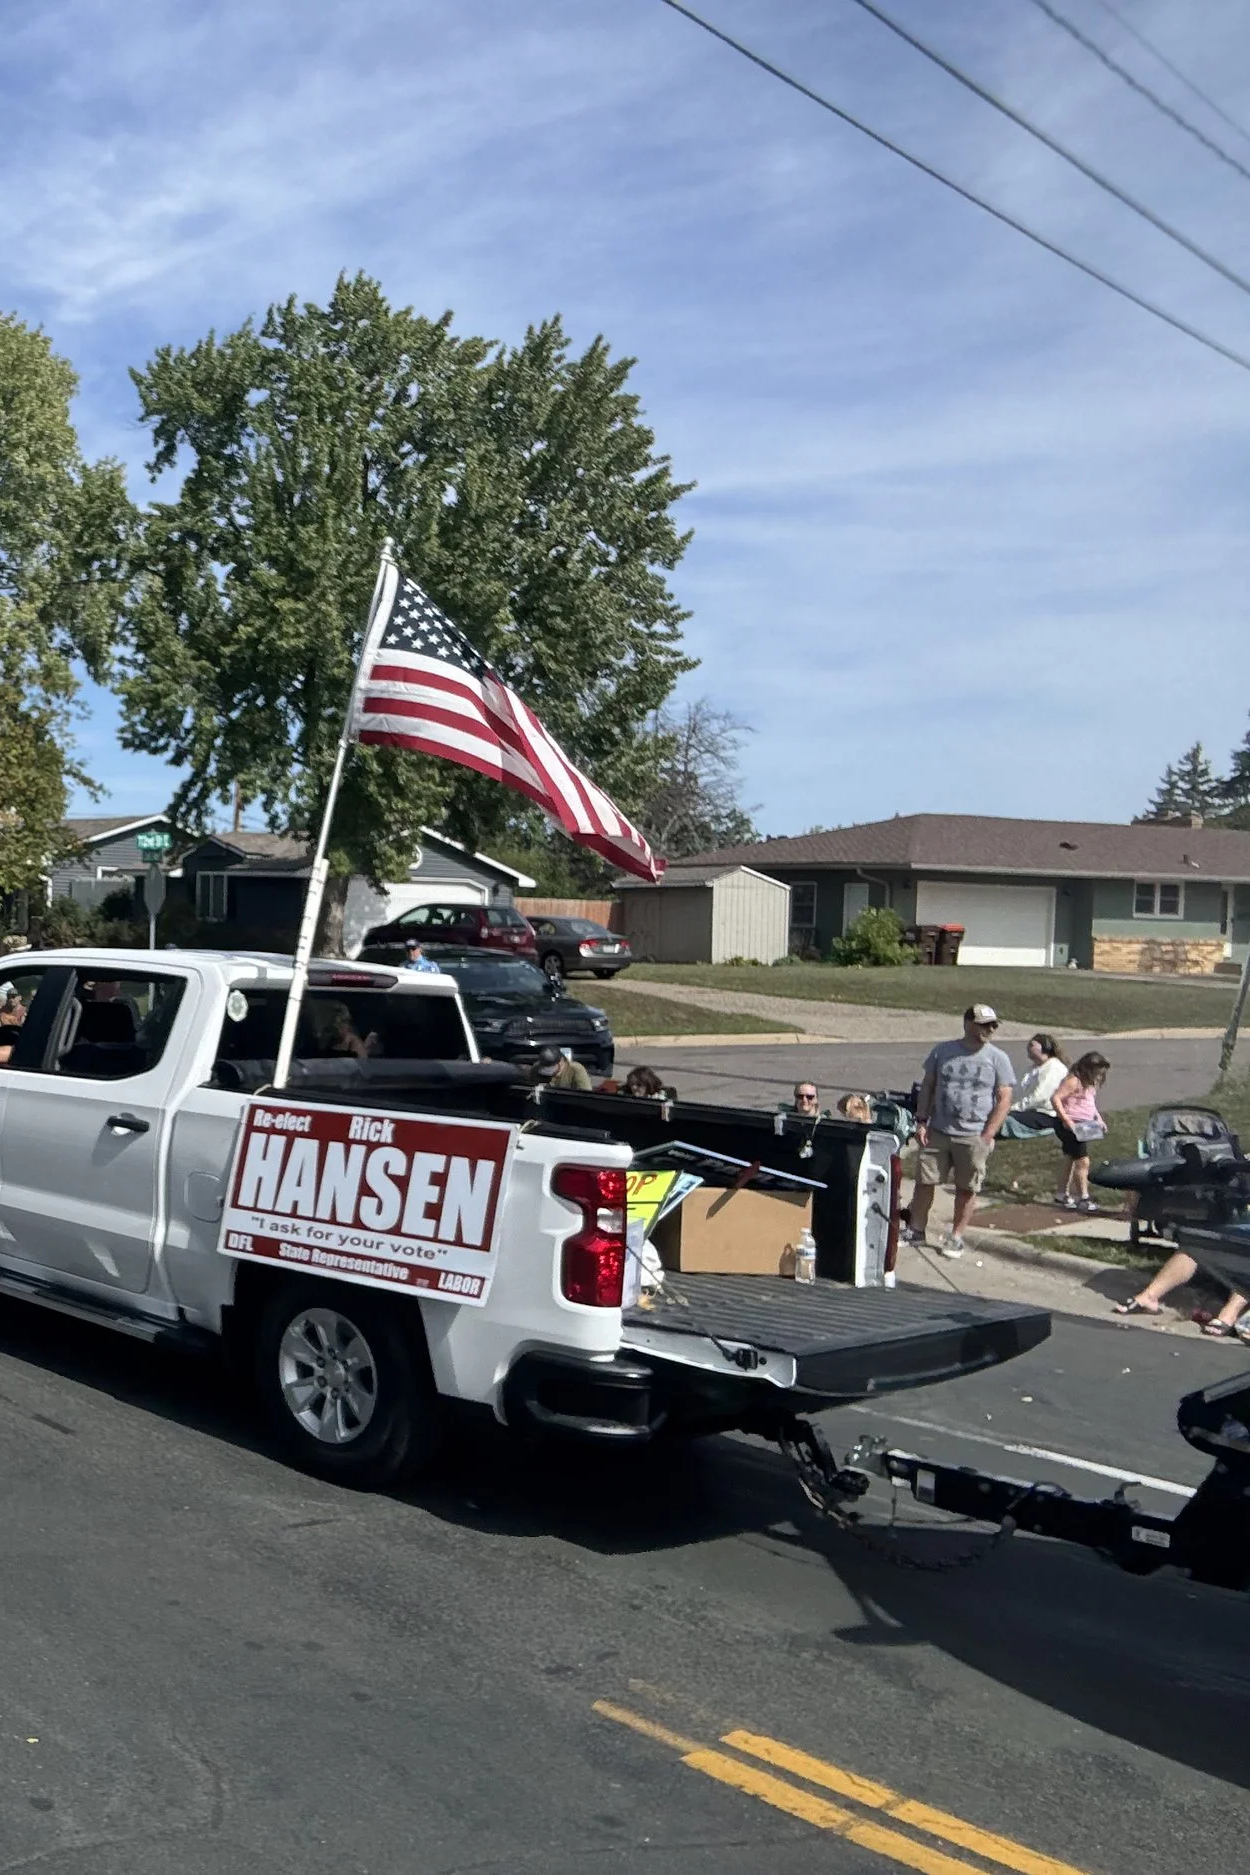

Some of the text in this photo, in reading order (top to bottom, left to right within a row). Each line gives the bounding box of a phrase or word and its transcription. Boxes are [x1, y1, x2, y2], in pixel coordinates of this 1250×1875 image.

[253, 1109, 397, 1143] Re-elect Rick
[237, 1133, 496, 1247] HANSEN
[270, 1223, 301, 1236] ask
[307, 1226, 334, 1241] for
[338, 1234, 386, 1250] your
[278, 1242, 311, 1262] State
[311, 1248, 409, 1280] Representative
[438, 1272, 482, 1295] LABOR
